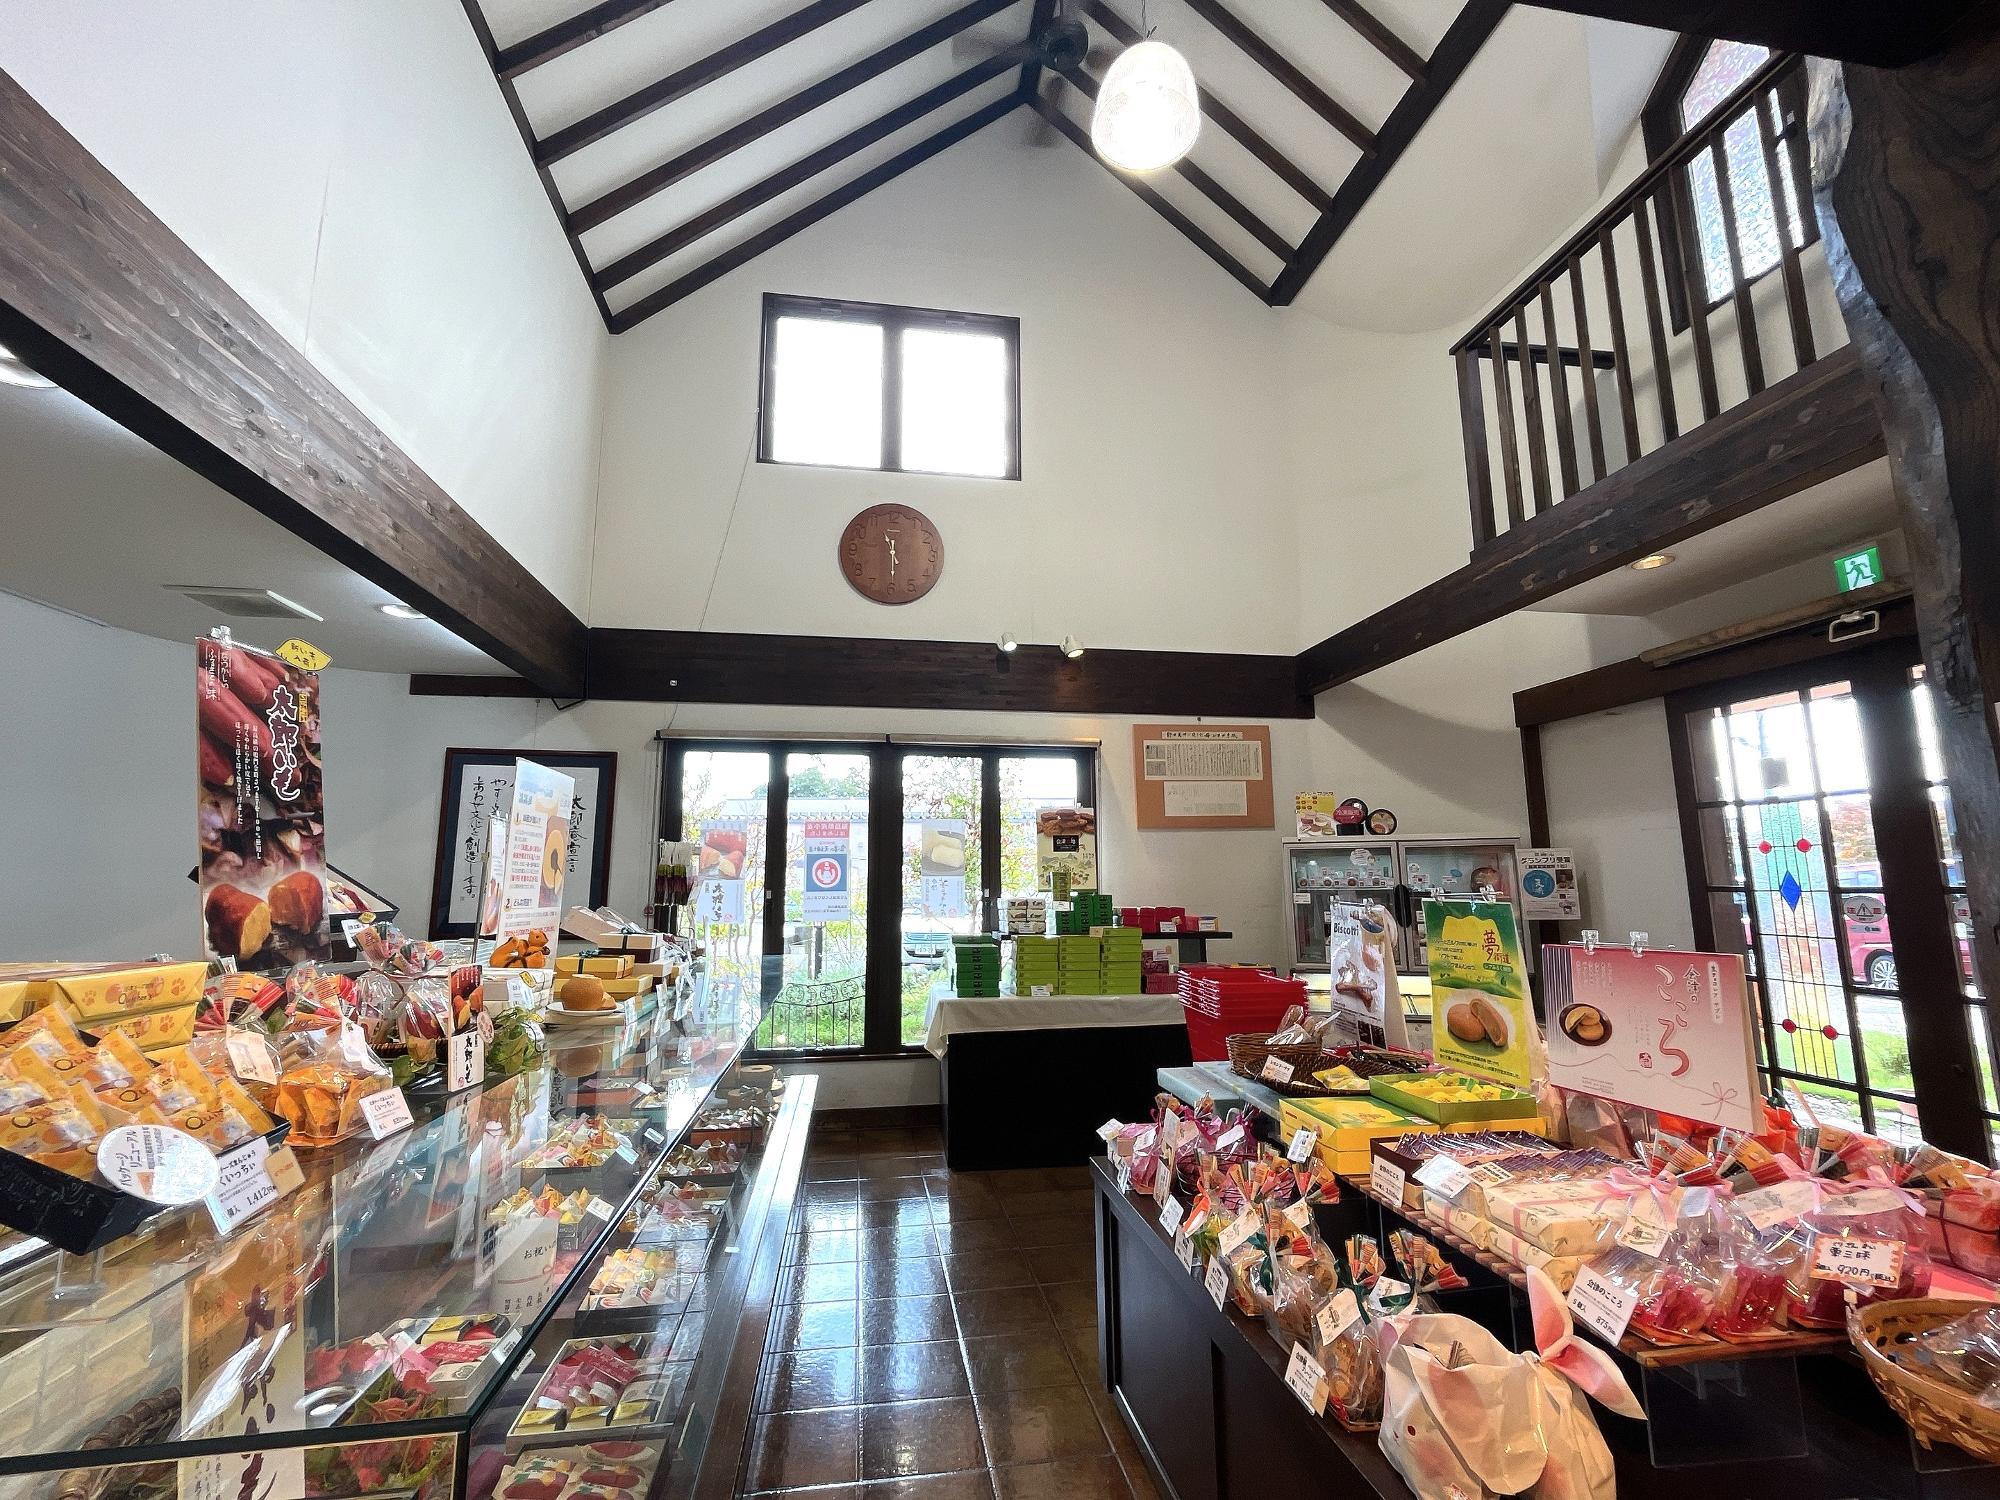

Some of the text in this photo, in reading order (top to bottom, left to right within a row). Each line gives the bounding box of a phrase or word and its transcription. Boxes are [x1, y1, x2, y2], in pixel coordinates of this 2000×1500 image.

[266, 685, 300, 800] 太郎いも
[1521, 856, 1571, 865] グランプリ受賞
[1333, 922, 1359, 936] Biscotti
[1683, 963, 1701, 1003] 会津の
[1655, 964, 1690, 1077] こころ
[465, 1036, 473, 1083] 太郎いも
[126, 1130, 142, 1168] リニューアル
[115, 1152, 132, 1187] パッケージ
[1837, 1264, 1870, 1277] 920円
[1586, 1279, 1623, 1309] 会津のこころ
